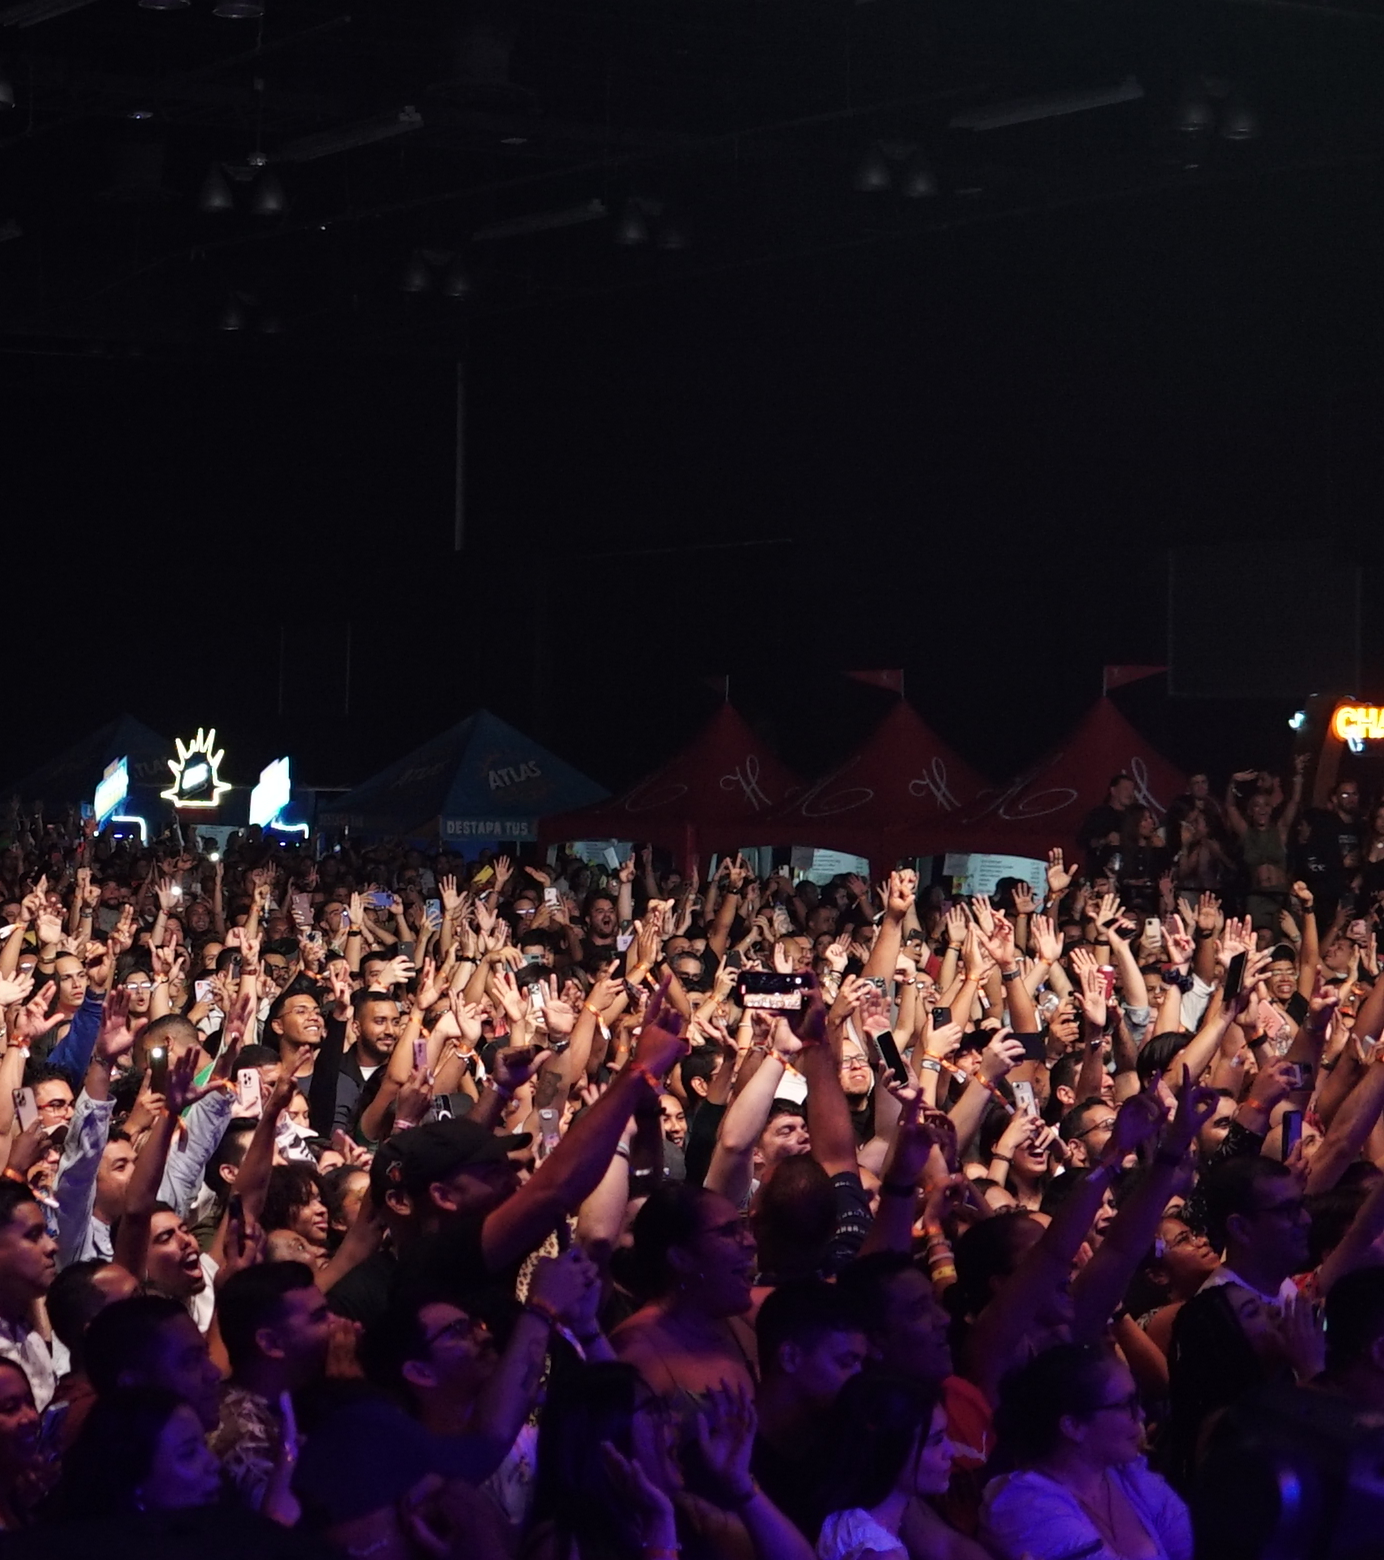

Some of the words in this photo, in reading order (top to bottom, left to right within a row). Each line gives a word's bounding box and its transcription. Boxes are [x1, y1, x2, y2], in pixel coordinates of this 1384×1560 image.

[1335, 706, 1384, 739] CH
[487, 760, 542, 791] ATLAS
[446, 820, 502, 836] DESTAPA
[504, 821, 529, 836] TUS
